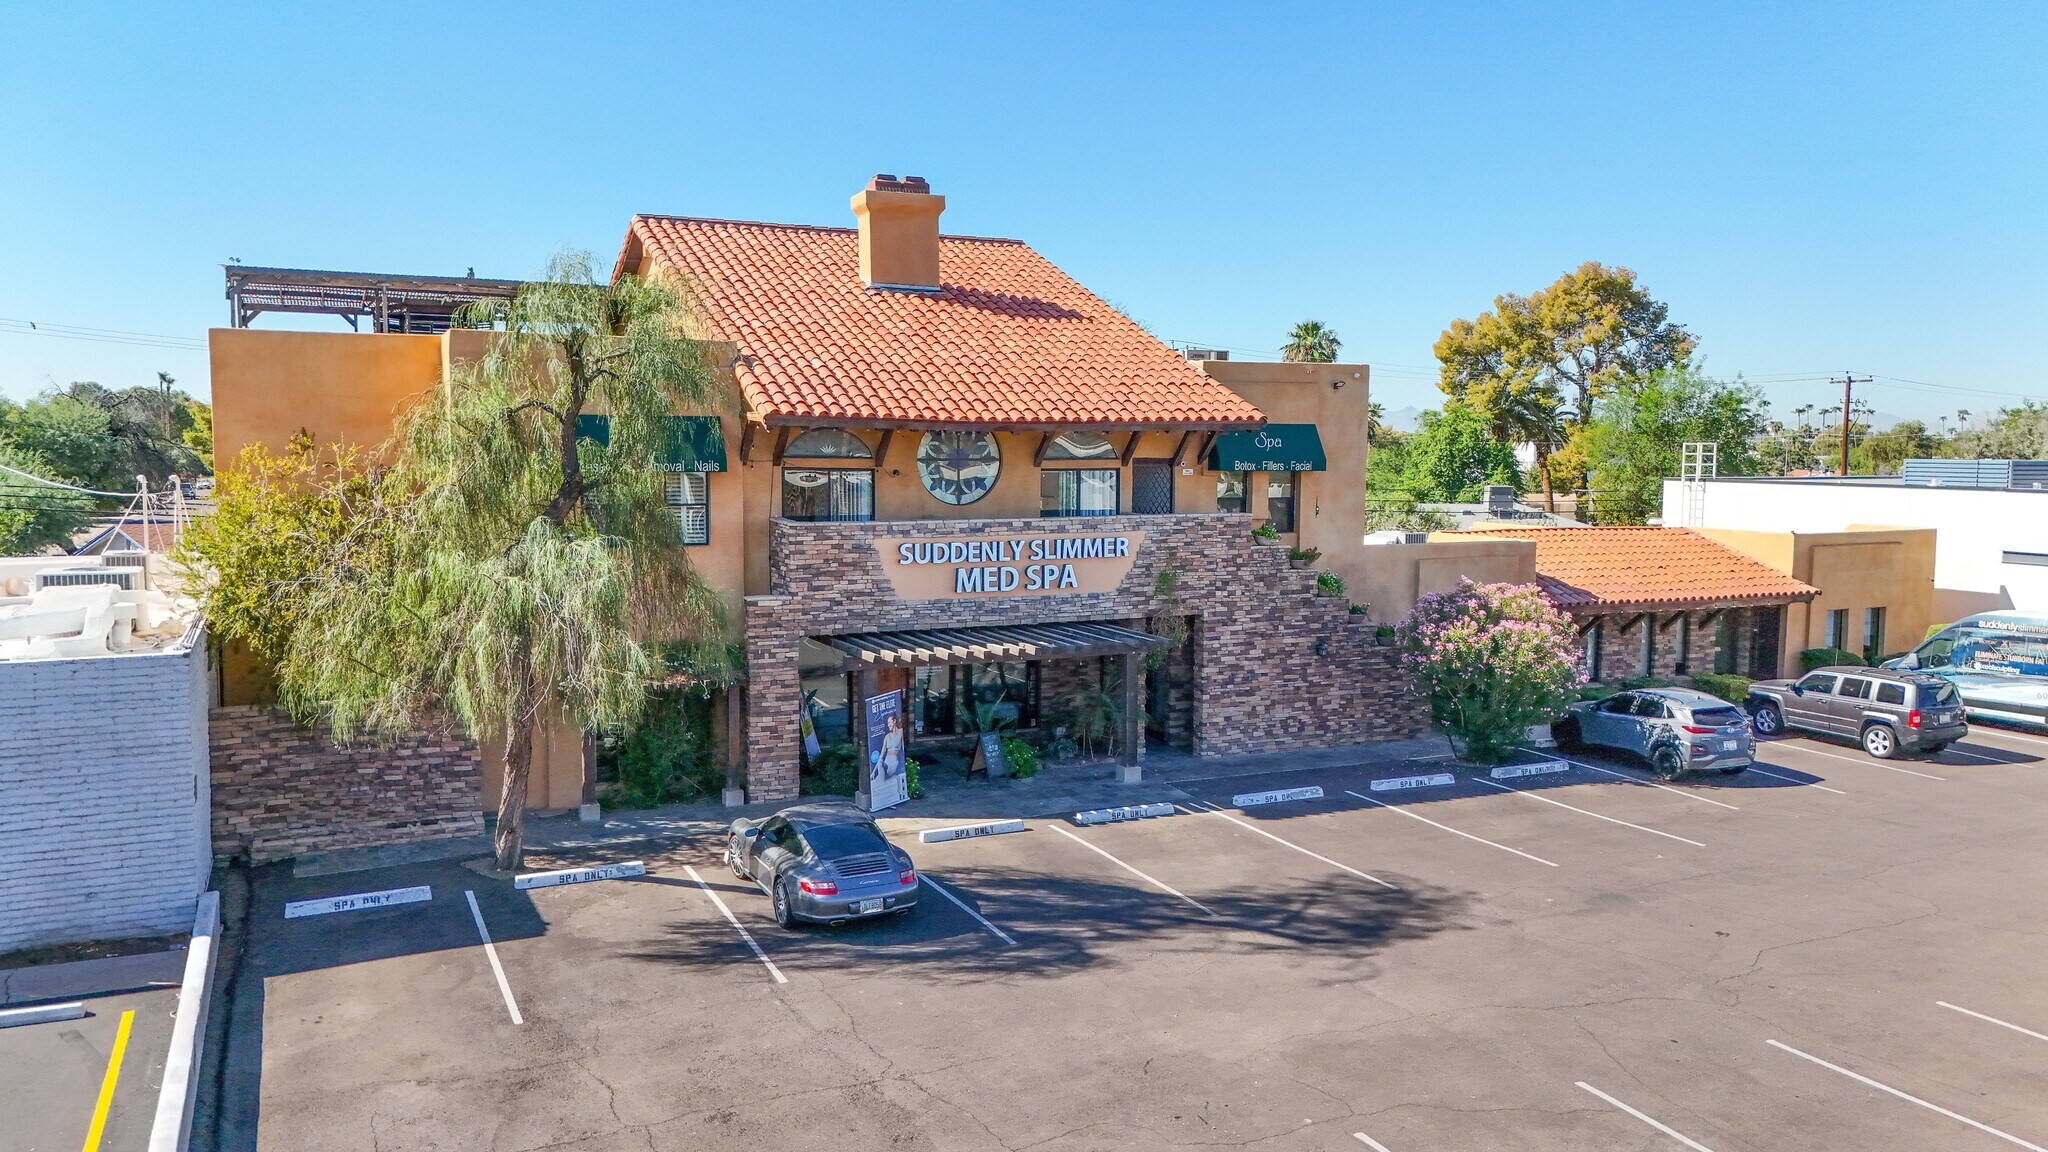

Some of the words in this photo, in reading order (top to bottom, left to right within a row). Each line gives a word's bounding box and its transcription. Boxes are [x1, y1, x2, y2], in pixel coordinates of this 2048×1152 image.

[1255, 431, 1282, 451] Spa
[694, 460, 720, 472] Nails
[1234, 460, 1256, 471] Botox
[1262, 460, 1285, 471] Fillers
[1290, 460, 1313, 471] Facial
[899, 540, 1026, 565] SUDDENLY
[1028, 537, 1130, 561] SLIMMER
[955, 566, 1020, 593] MED
[1024, 564, 1079, 590] SPA
[1400, 780, 1412, 788] SPA
[1264, 794, 1278, 803] SPA
[1111, 811, 1126, 820] SPA
[1130, 809, 1148, 818] ONLY
[955, 829, 970, 838] SPA
[974, 824, 994, 836] ONLY
[559, 873, 578, 884] SPA
[584, 869, 609, 881] ONLY
[334, 899, 355, 911] SPA
